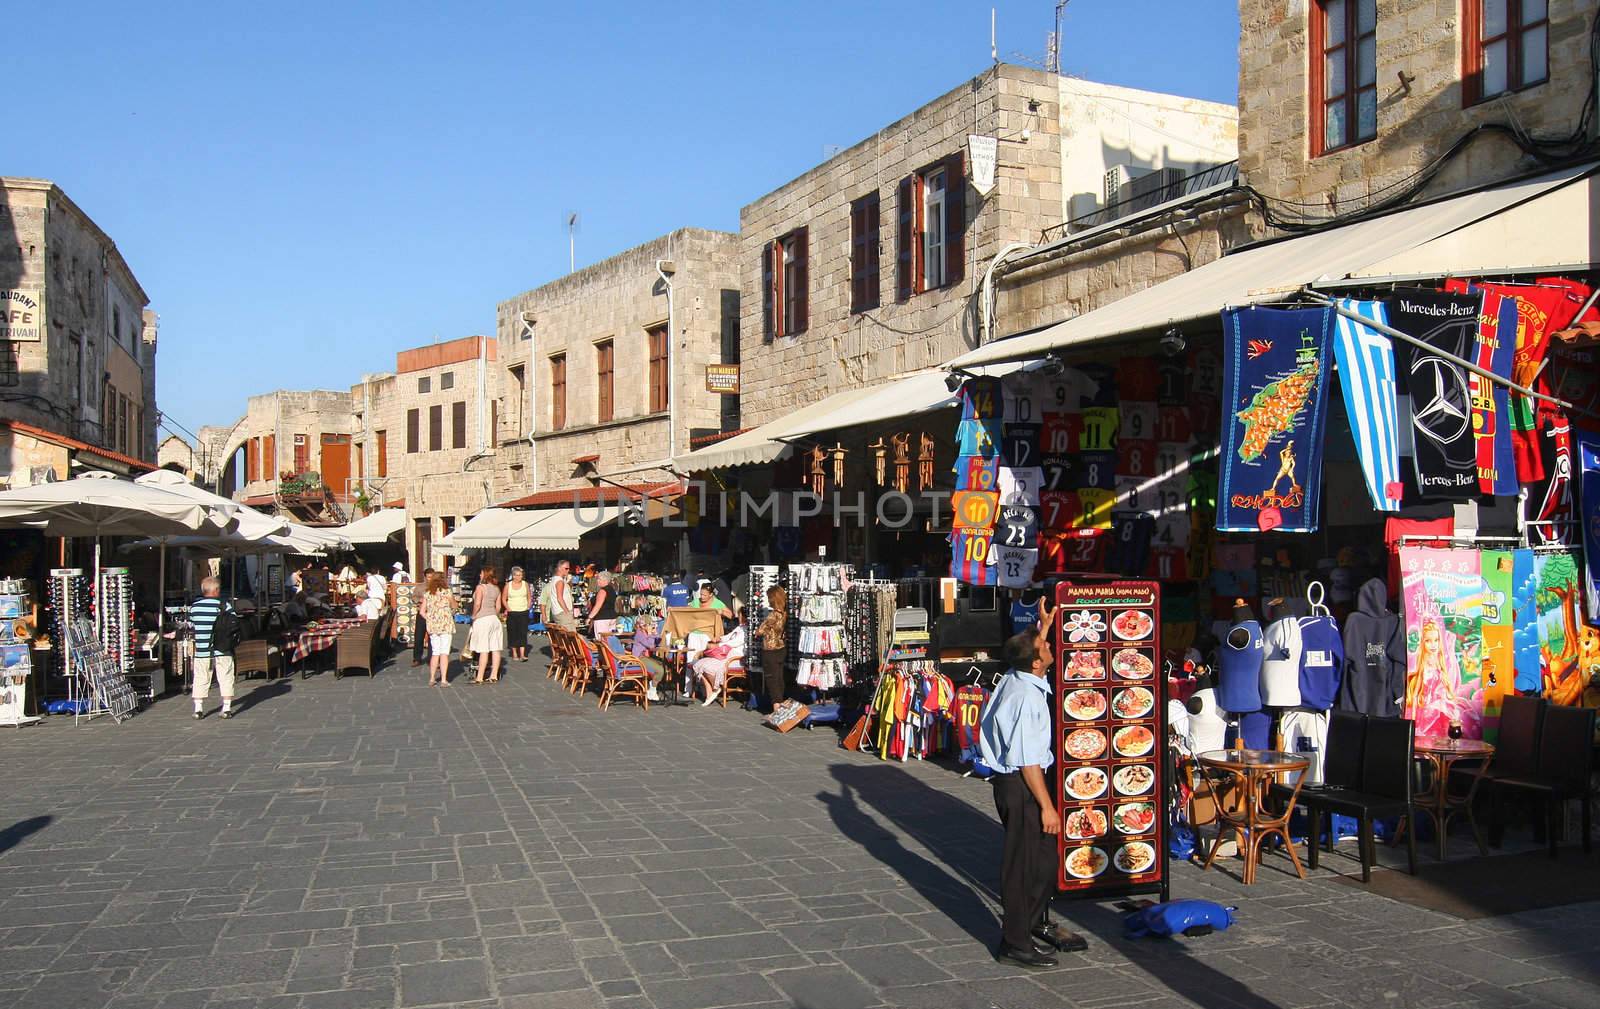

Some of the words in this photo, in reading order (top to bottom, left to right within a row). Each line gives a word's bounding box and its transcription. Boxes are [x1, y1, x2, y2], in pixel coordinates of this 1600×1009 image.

[1400, 299, 1475, 316] Mercedes-Benz
[970, 470, 993, 490] 19
[1049, 466, 1062, 490] 7
[1088, 463, 1098, 486] 8
[970, 503, 989, 523] 10
[1049, 502, 1061, 528] 7
[1006, 524, 1026, 547] 23
[965, 537, 987, 562] 10
[1006, 562, 1020, 578] 23
[1068, 588, 1094, 596] MAMMA
[1095, 587, 1115, 596] MARIA
[960, 703, 979, 727] 10
